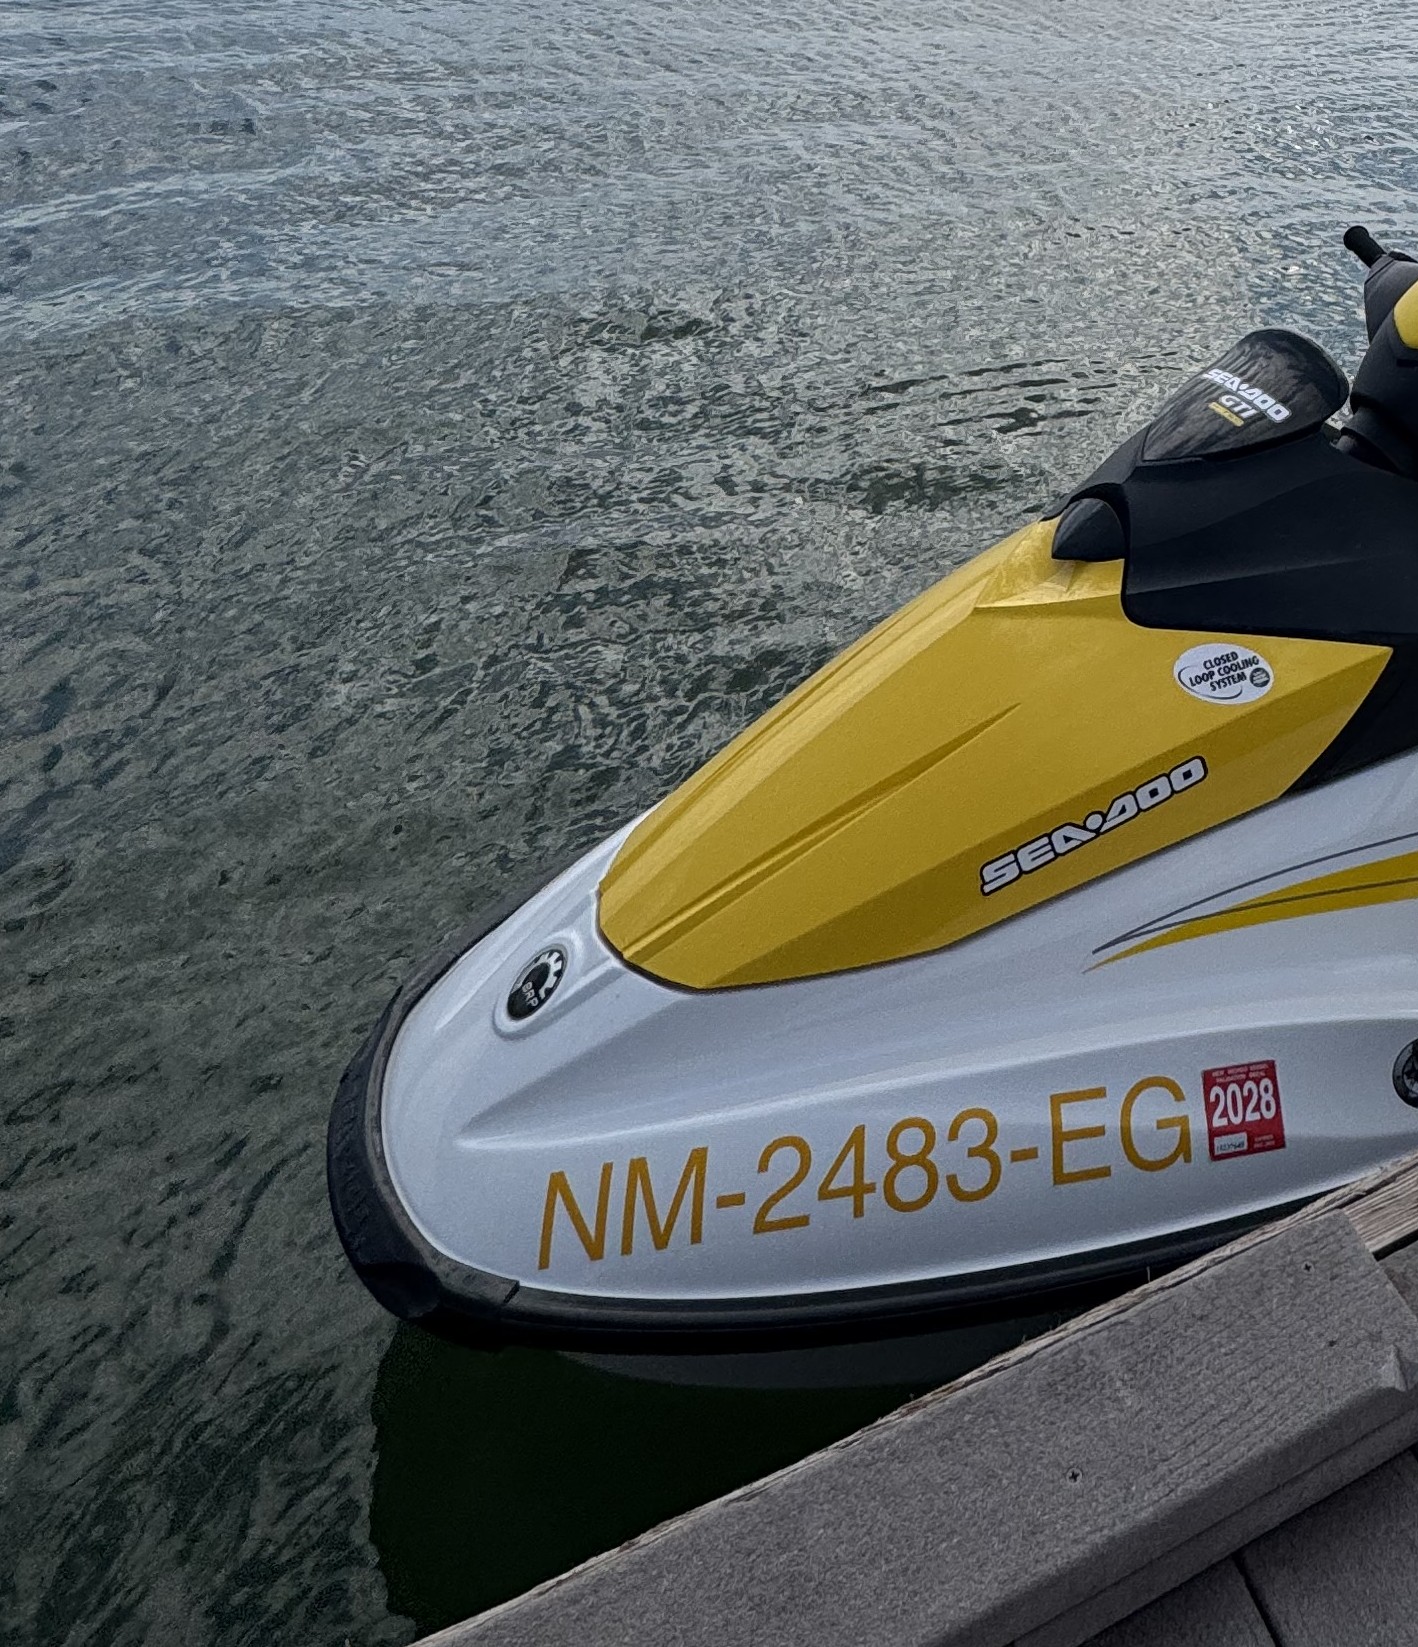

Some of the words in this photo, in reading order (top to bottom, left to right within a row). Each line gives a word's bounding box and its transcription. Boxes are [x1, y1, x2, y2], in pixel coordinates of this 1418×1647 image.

[1218, 394, 1258, 419] GTI
[1189, 670, 1215, 687] LOOP
[1217, 655, 1260, 677] COOLING
[1203, 651, 1239, 670] CLOSED
[1209, 671, 1247, 692] SYSTEM
[521, 981, 539, 1008] BRP
[1209, 1077, 1277, 1129] 2028
[537, 1075, 1192, 1271] NM-2483-EG
